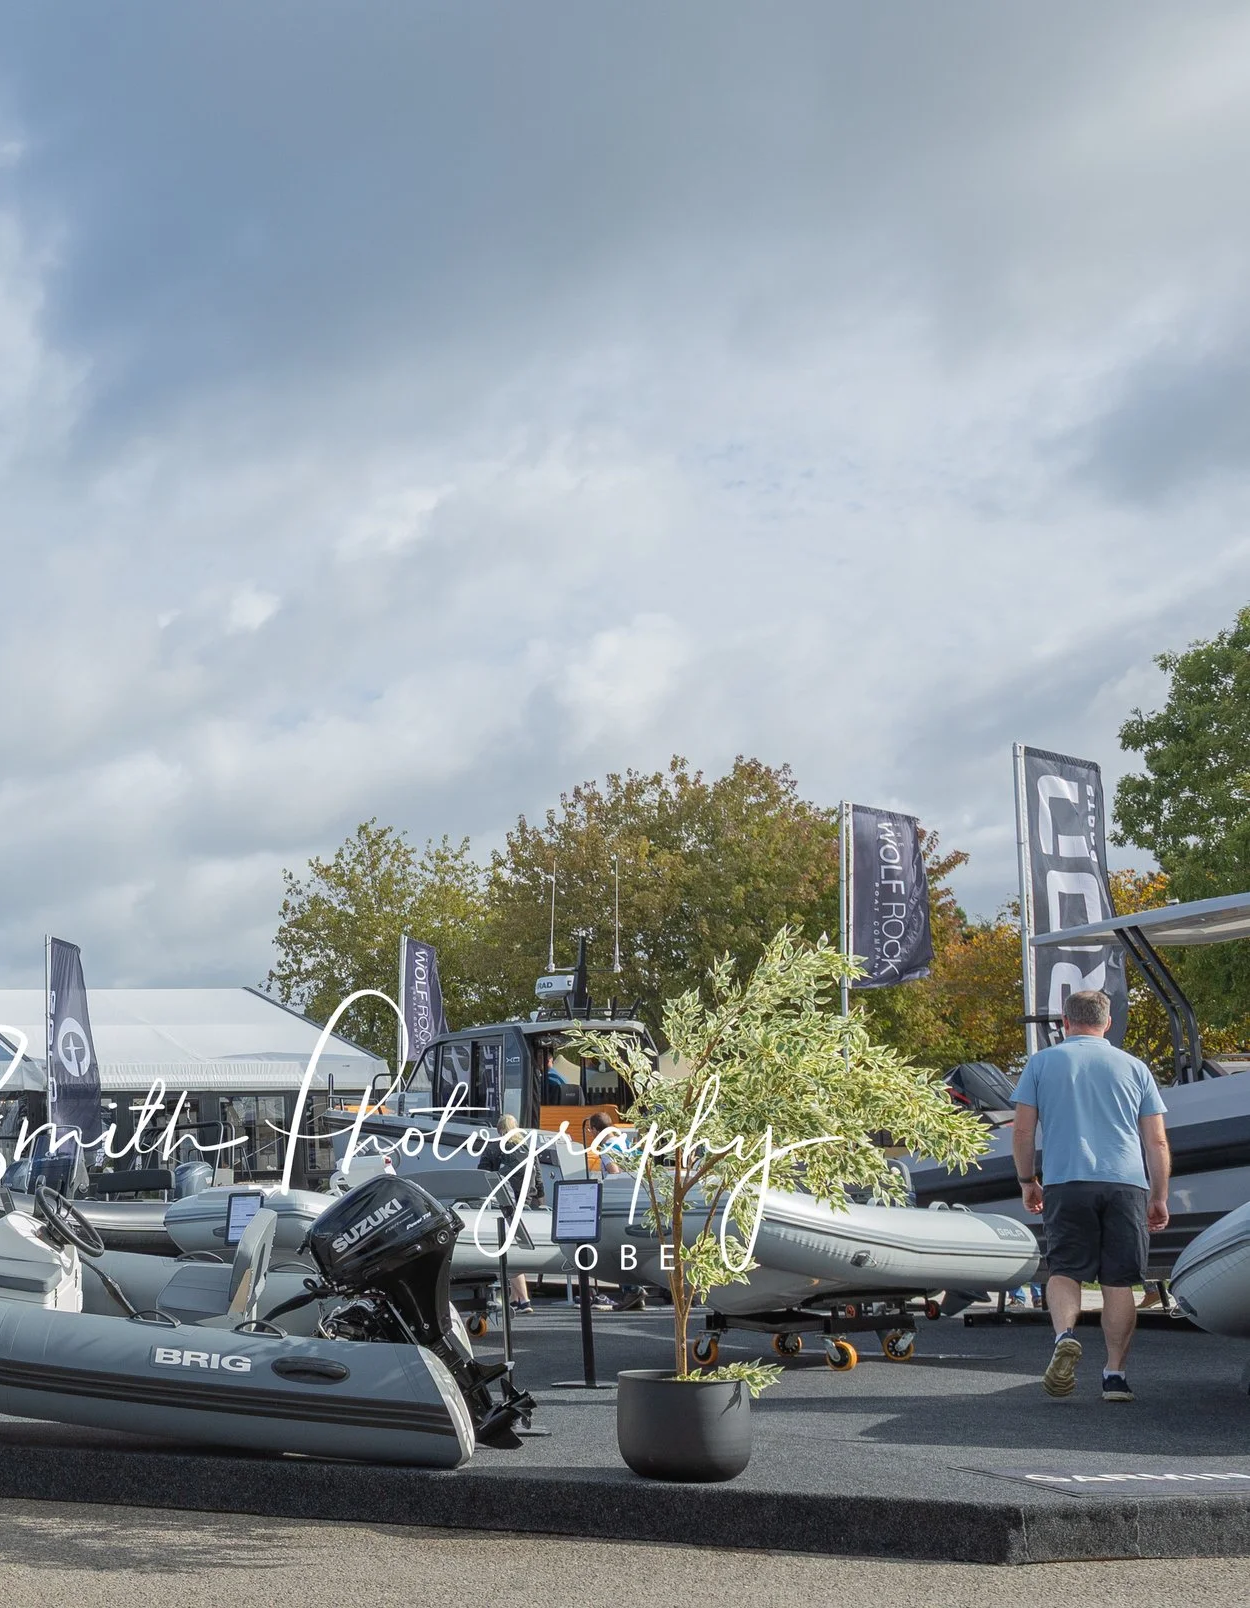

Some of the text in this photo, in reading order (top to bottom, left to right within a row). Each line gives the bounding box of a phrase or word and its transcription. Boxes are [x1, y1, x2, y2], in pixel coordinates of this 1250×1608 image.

[877, 821, 907, 976] WOLF ROCK
[414, 950, 428, 1002] WOLF
[331, 1198, 403, 1253] SUZUKI
[154, 1347, 252, 1372] BRIG
